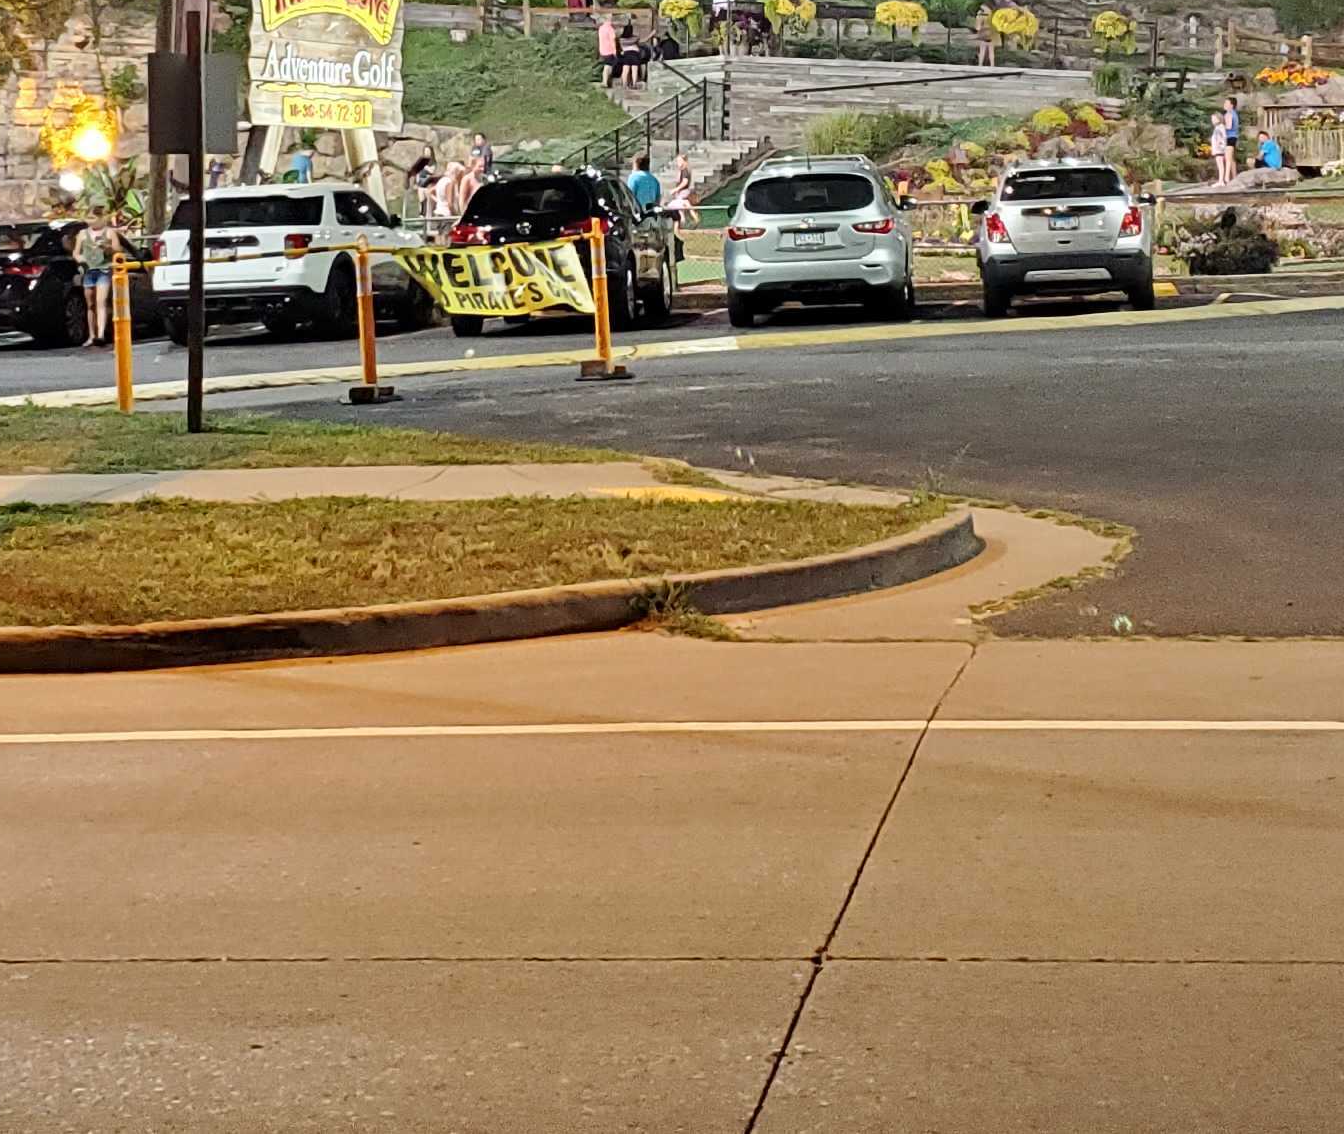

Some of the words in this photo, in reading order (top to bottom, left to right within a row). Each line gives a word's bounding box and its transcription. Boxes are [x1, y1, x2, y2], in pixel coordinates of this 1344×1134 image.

[262, 41, 351, 84] Adventure
[353, 51, 395, 87] Golf
[455, 282, 543, 310] PIRATE'S
